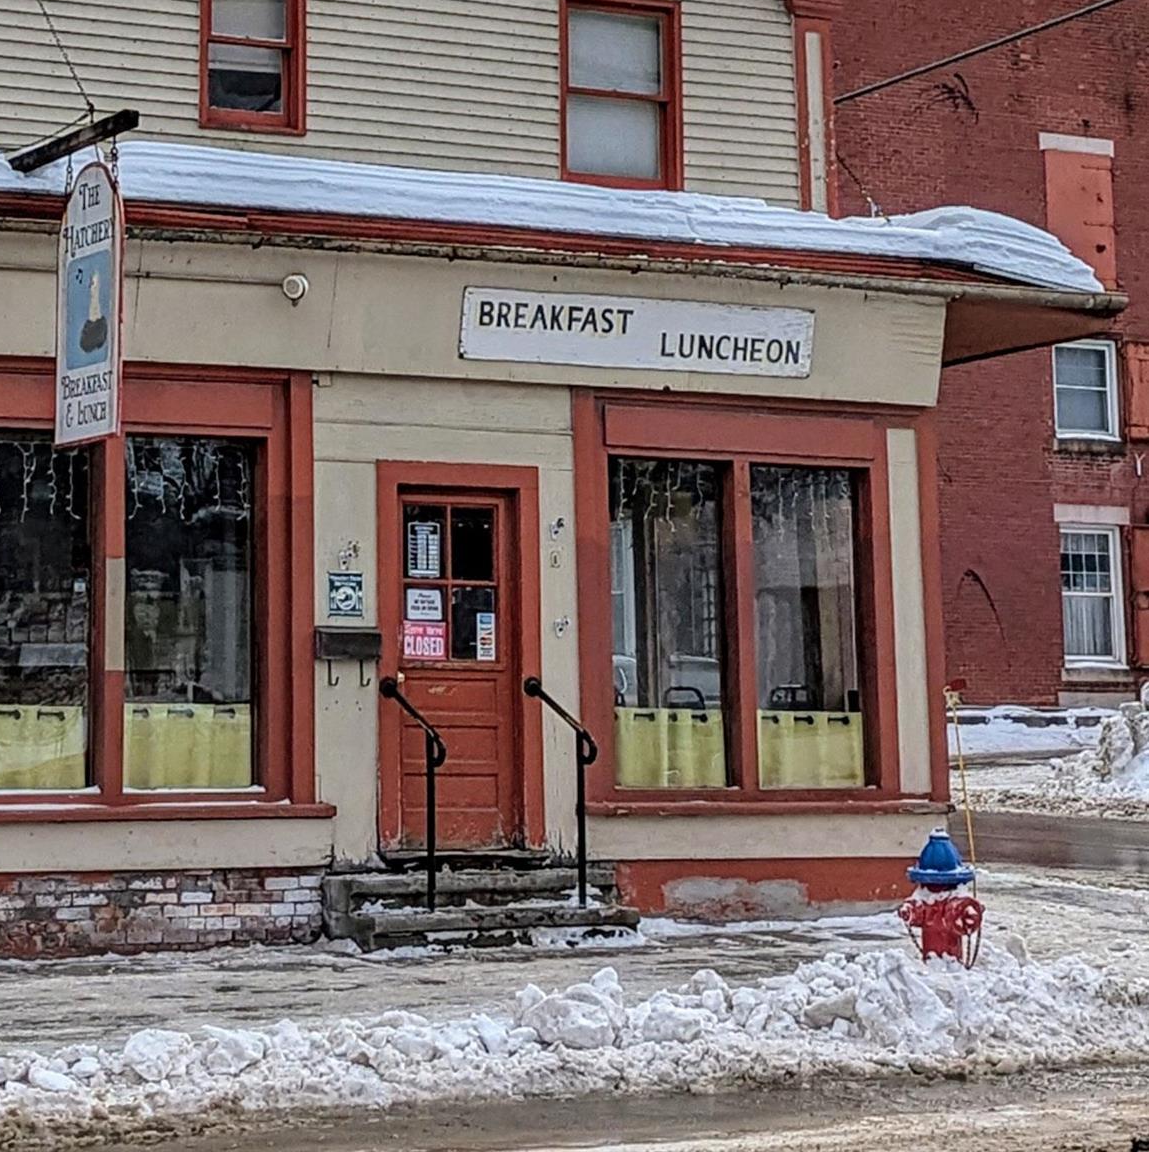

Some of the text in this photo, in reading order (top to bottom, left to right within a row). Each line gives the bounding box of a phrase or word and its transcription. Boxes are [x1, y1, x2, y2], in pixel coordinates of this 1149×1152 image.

[79, 183, 100, 210] THE
[478, 300, 634, 335] BREAKFAST
[660, 332, 801, 365] LUNCHEON
[61, 370, 113, 400] BREAKFAST
[66, 400, 107, 428] & LUNCH
[404, 635, 444, 656] CLOSED
